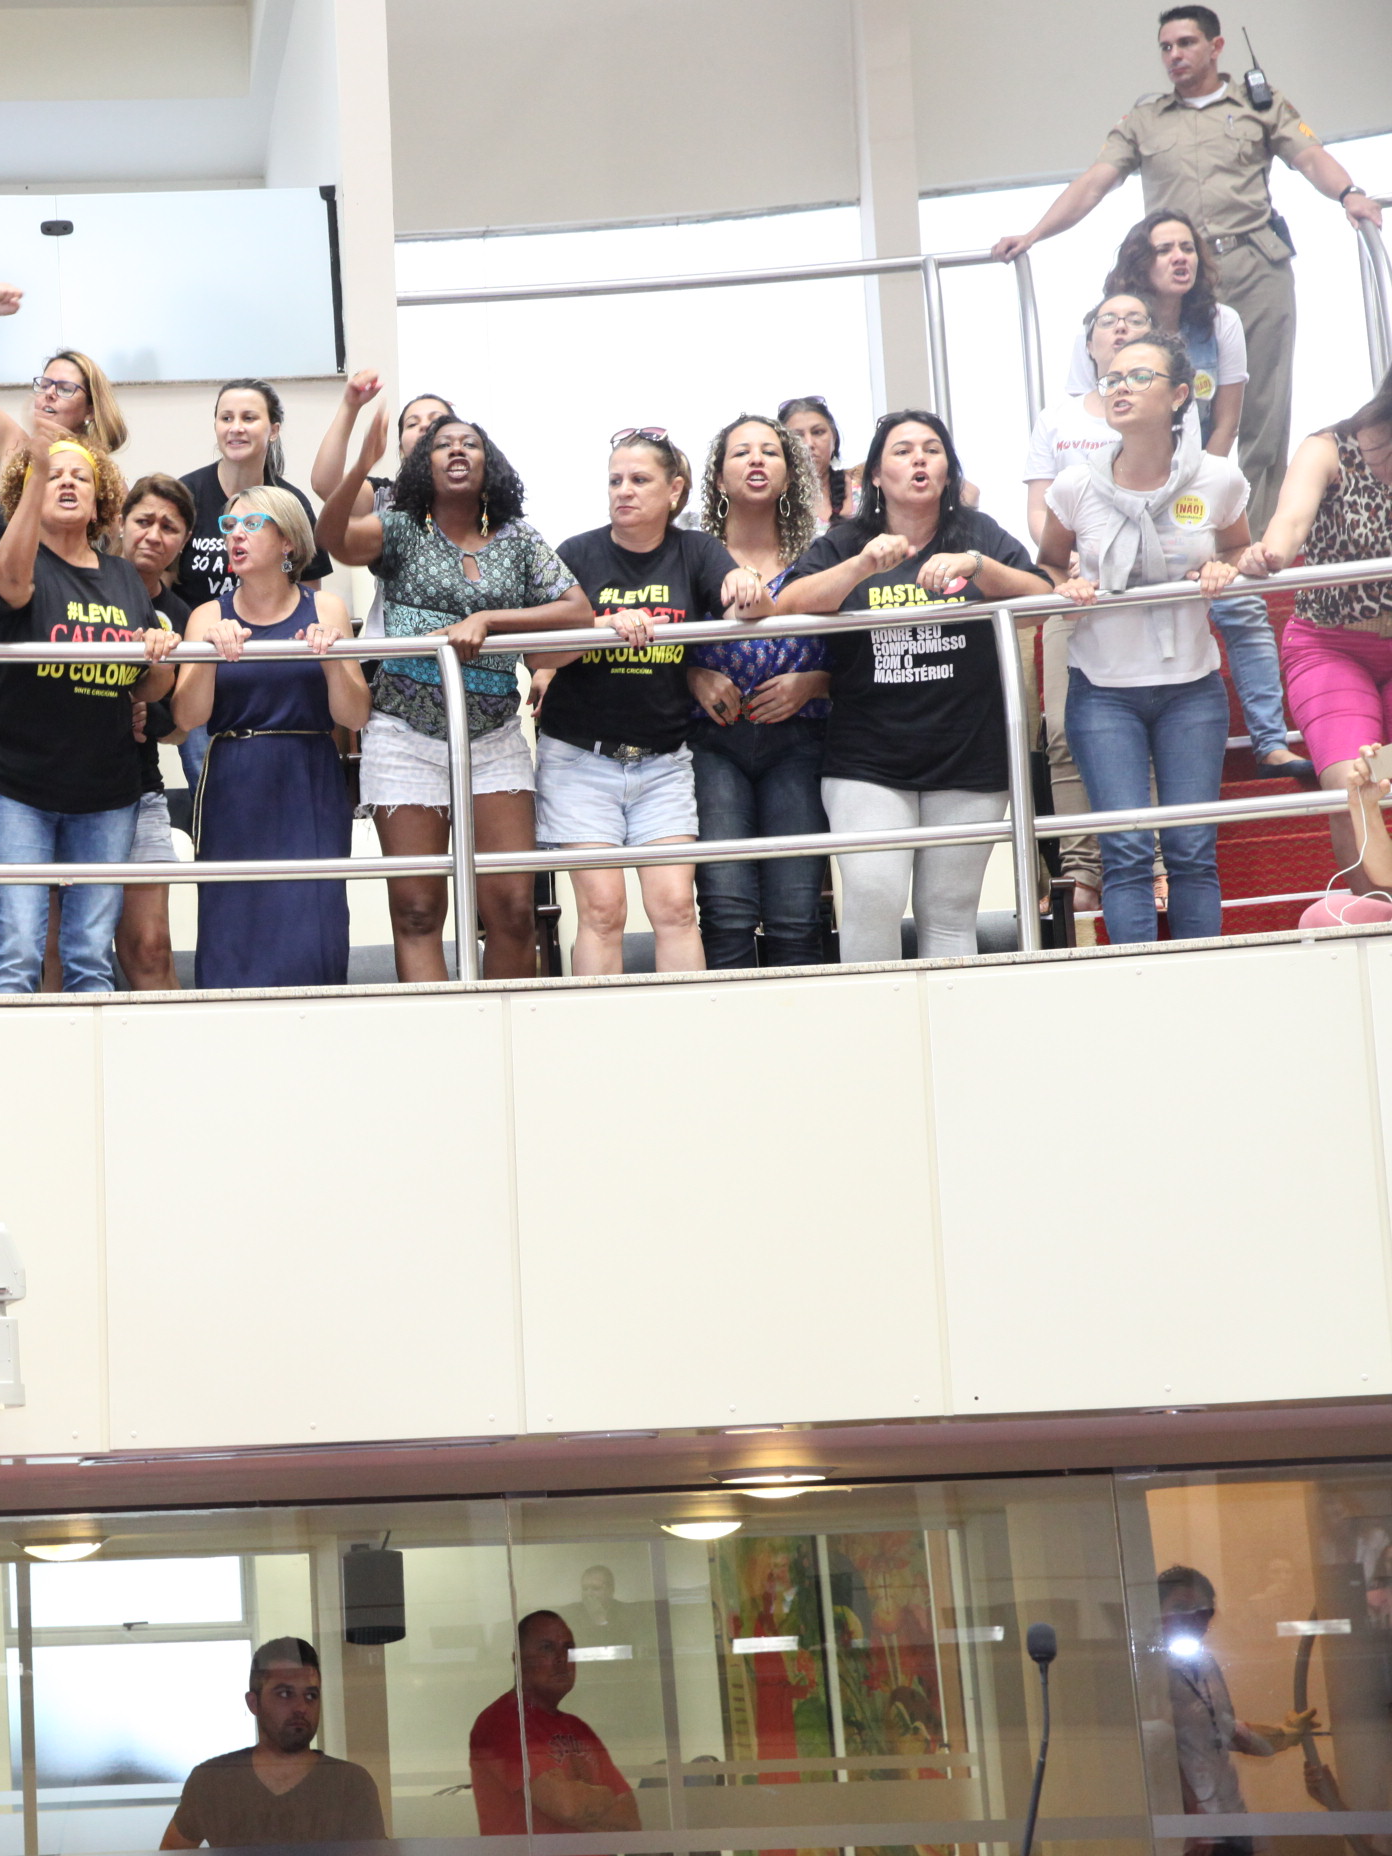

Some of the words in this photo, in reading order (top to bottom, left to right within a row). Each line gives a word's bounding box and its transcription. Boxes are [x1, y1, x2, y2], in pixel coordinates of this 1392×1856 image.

[191, 552, 209, 571] SÓ
[212, 556, 224, 575] A
[599, 585, 670, 604] #LEVEI
[868, 584, 928, 606] BASTA
[67, 601, 128, 627] #LEVEI
[50, 624, 134, 643] CALOT
[870, 626, 914, 644] HONRE
[916, 625, 942, 640] SEU
[605, 644, 685, 664] COLOMBO
[872, 634, 967, 656] COMPROMISSO
[37, 663, 65, 679] DO
[875, 655, 901, 670] COM
[904, 654, 913, 670] O
[874, 664, 954, 684] MAGISTÉRIO!
